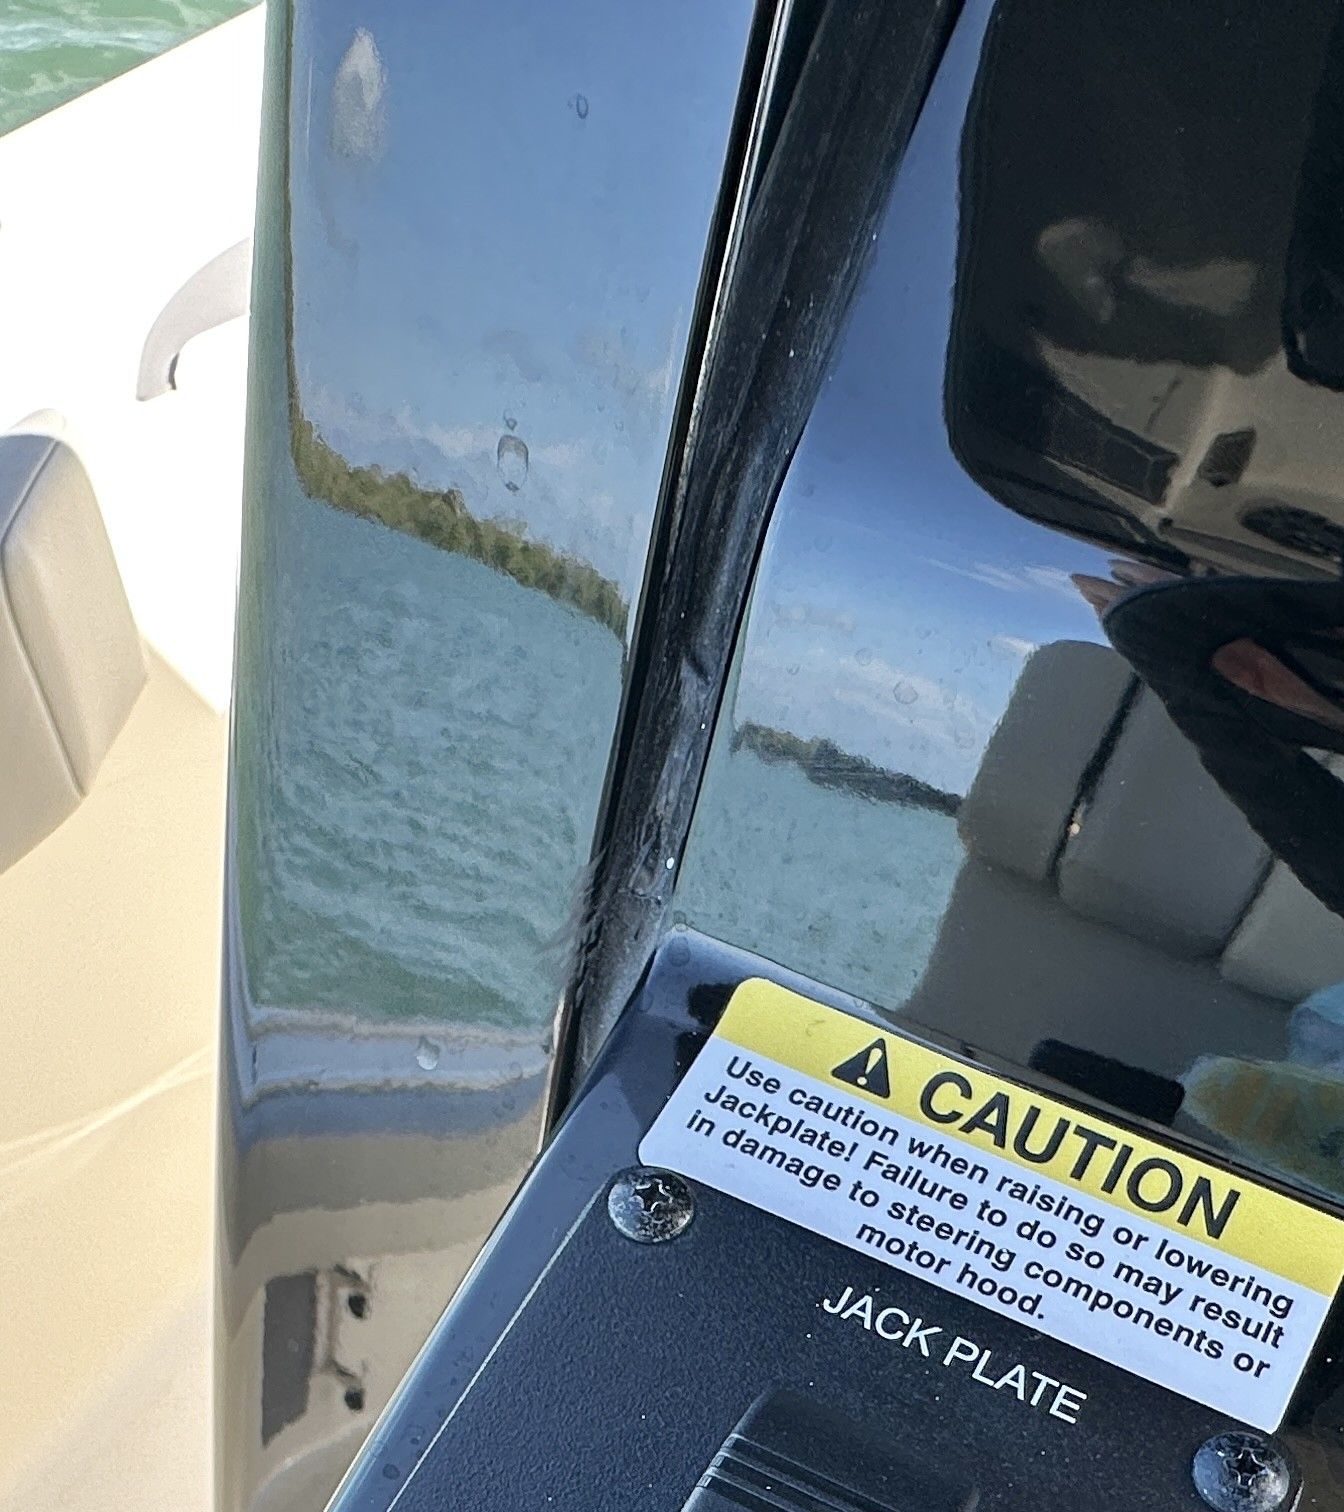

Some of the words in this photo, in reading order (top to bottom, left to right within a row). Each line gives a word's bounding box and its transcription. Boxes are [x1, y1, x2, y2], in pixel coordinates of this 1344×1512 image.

[686, 1109, 716, 1137] in
[722, 1129, 841, 1191] damage
[848, 1180, 880, 1208] to
[886, 1201, 1017, 1272] steering
[1024, 1261, 1224, 1360] components
[1233, 1352, 1271, 1379] or
[704, 1085, 859, 1162] Jackplate!
[862, 1150, 968, 1211] Failure
[976, 1199, 1008, 1227] to
[1016, 1219, 1057, 1249] do
[1064, 1242, 1105, 1270] so
[1112, 1261, 1184, 1306] may
[1188, 1294, 1285, 1349] result
[726, 1055, 781, 1095] Use
[788, 1088, 899, 1147] caution
[908, 1136, 989, 1184] when
[995, 1175, 1105, 1238] raising
[1112, 1227, 1150, 1251] or
[1154, 1238, 1294, 1320] lowering
[919, 1071, 1241, 1240] CAUTION
[822, 1286, 943, 1357] JACK
[942, 1336, 1088, 1424] PLATE
[855, 1223, 952, 1275] motor
[956, 1262, 1044, 1320] hood.
